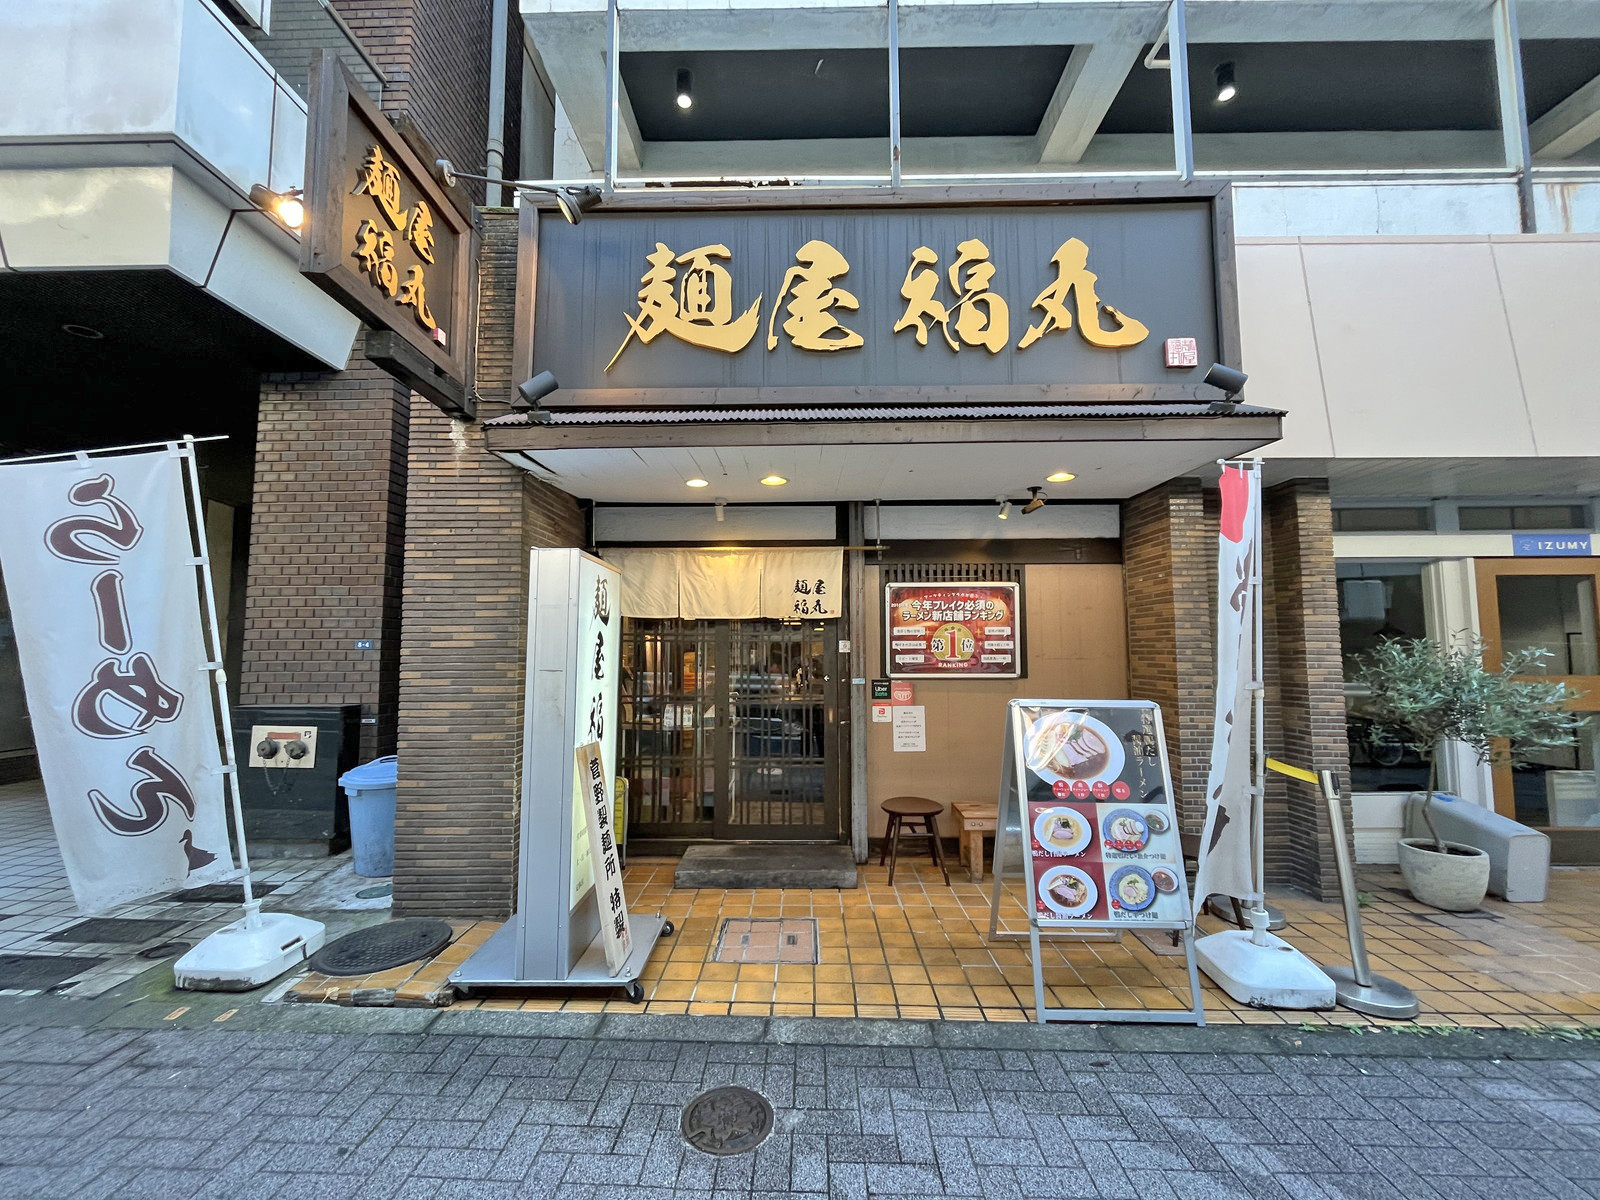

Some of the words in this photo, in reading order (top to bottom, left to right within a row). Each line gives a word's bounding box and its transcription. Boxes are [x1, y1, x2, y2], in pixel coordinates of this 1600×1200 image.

[351, 219, 437, 330] 福丸
[1537, 541, 1588, 550] IZUMY
[902, 610, 1004, 621] ラーメン新店舗ランキング
